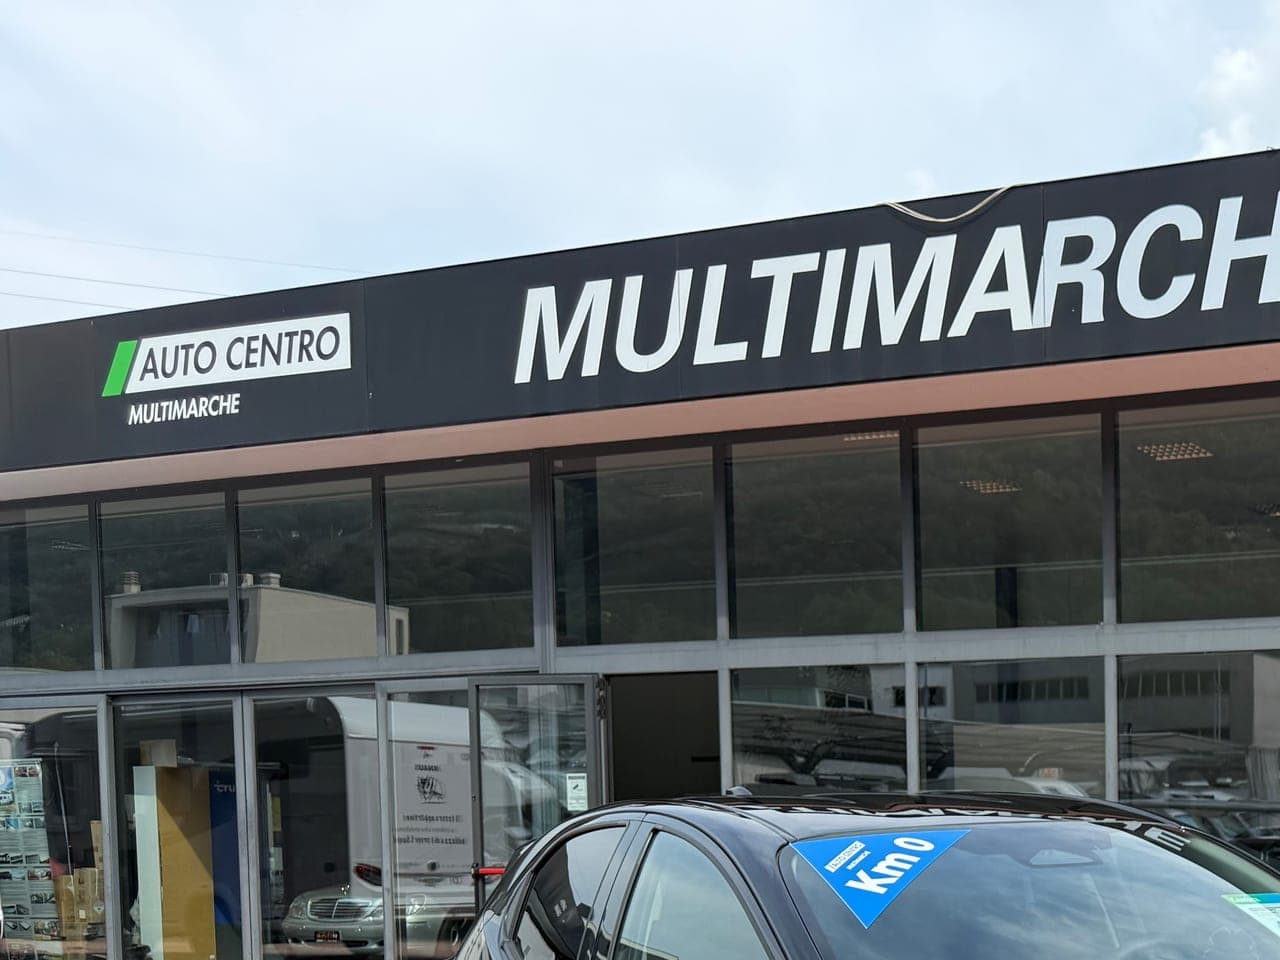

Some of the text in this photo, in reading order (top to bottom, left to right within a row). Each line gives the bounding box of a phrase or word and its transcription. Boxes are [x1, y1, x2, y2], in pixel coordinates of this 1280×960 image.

[139, 326, 340, 381] AUTO CENTRO
[128, 393, 240, 425] MULTIMARCHE
[844, 852, 920, 895] Km
